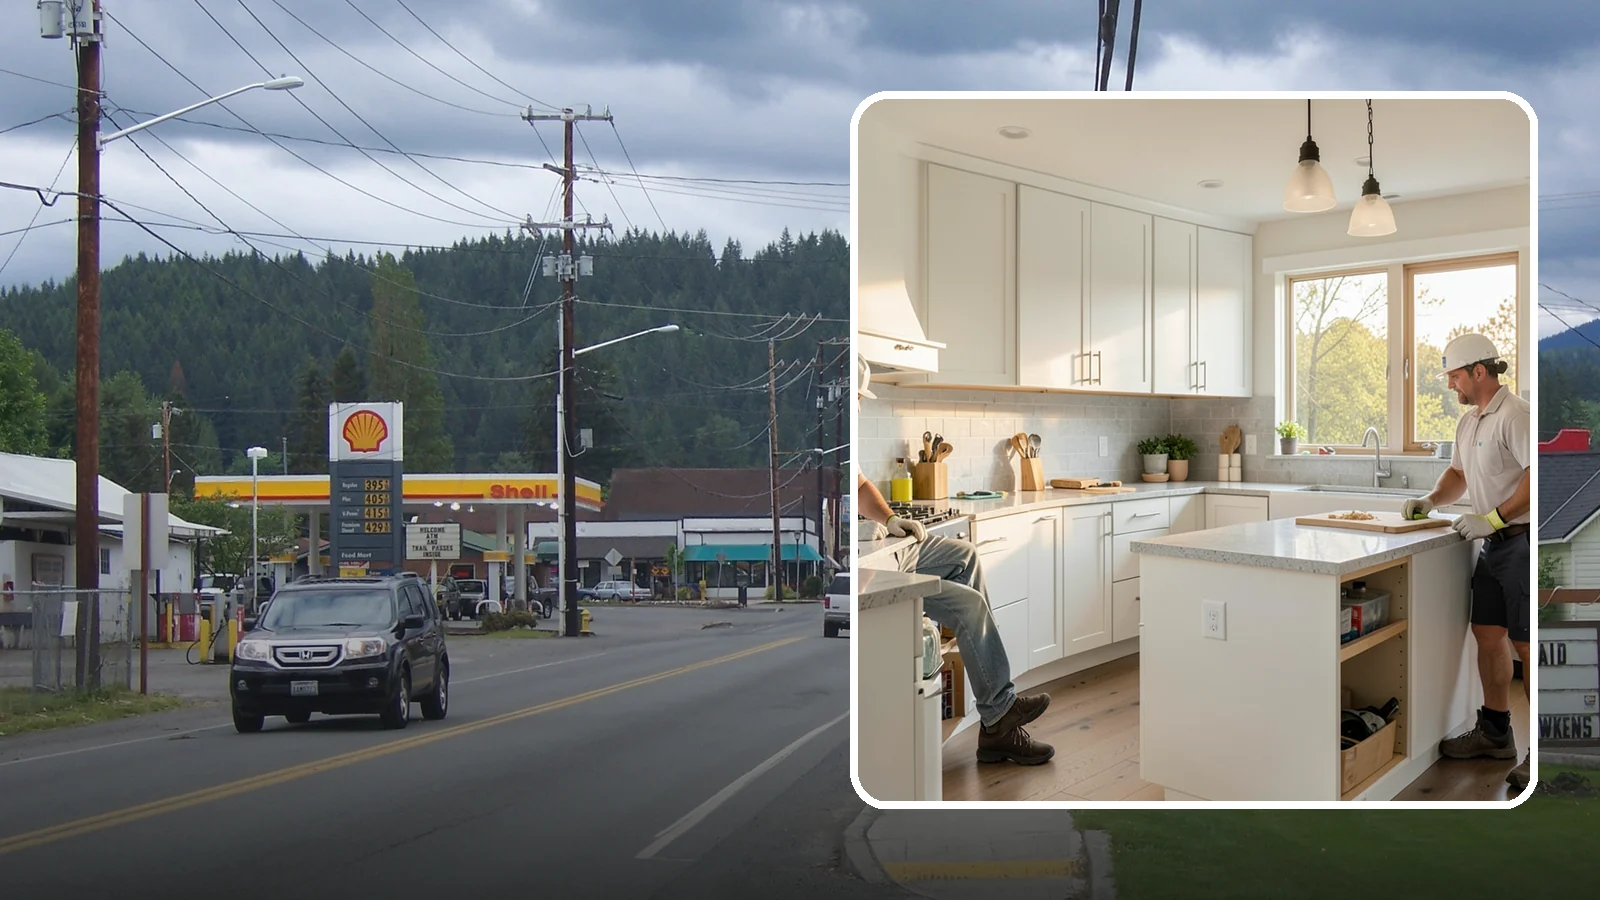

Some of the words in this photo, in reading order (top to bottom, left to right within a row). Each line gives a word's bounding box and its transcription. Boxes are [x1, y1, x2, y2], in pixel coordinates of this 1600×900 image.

[365, 480, 383, 490] 395
[490, 484, 547, 499] Shell
[365, 494, 383, 504] 405
[365, 507, 383, 518] 415
[365, 522, 383, 533] 429
